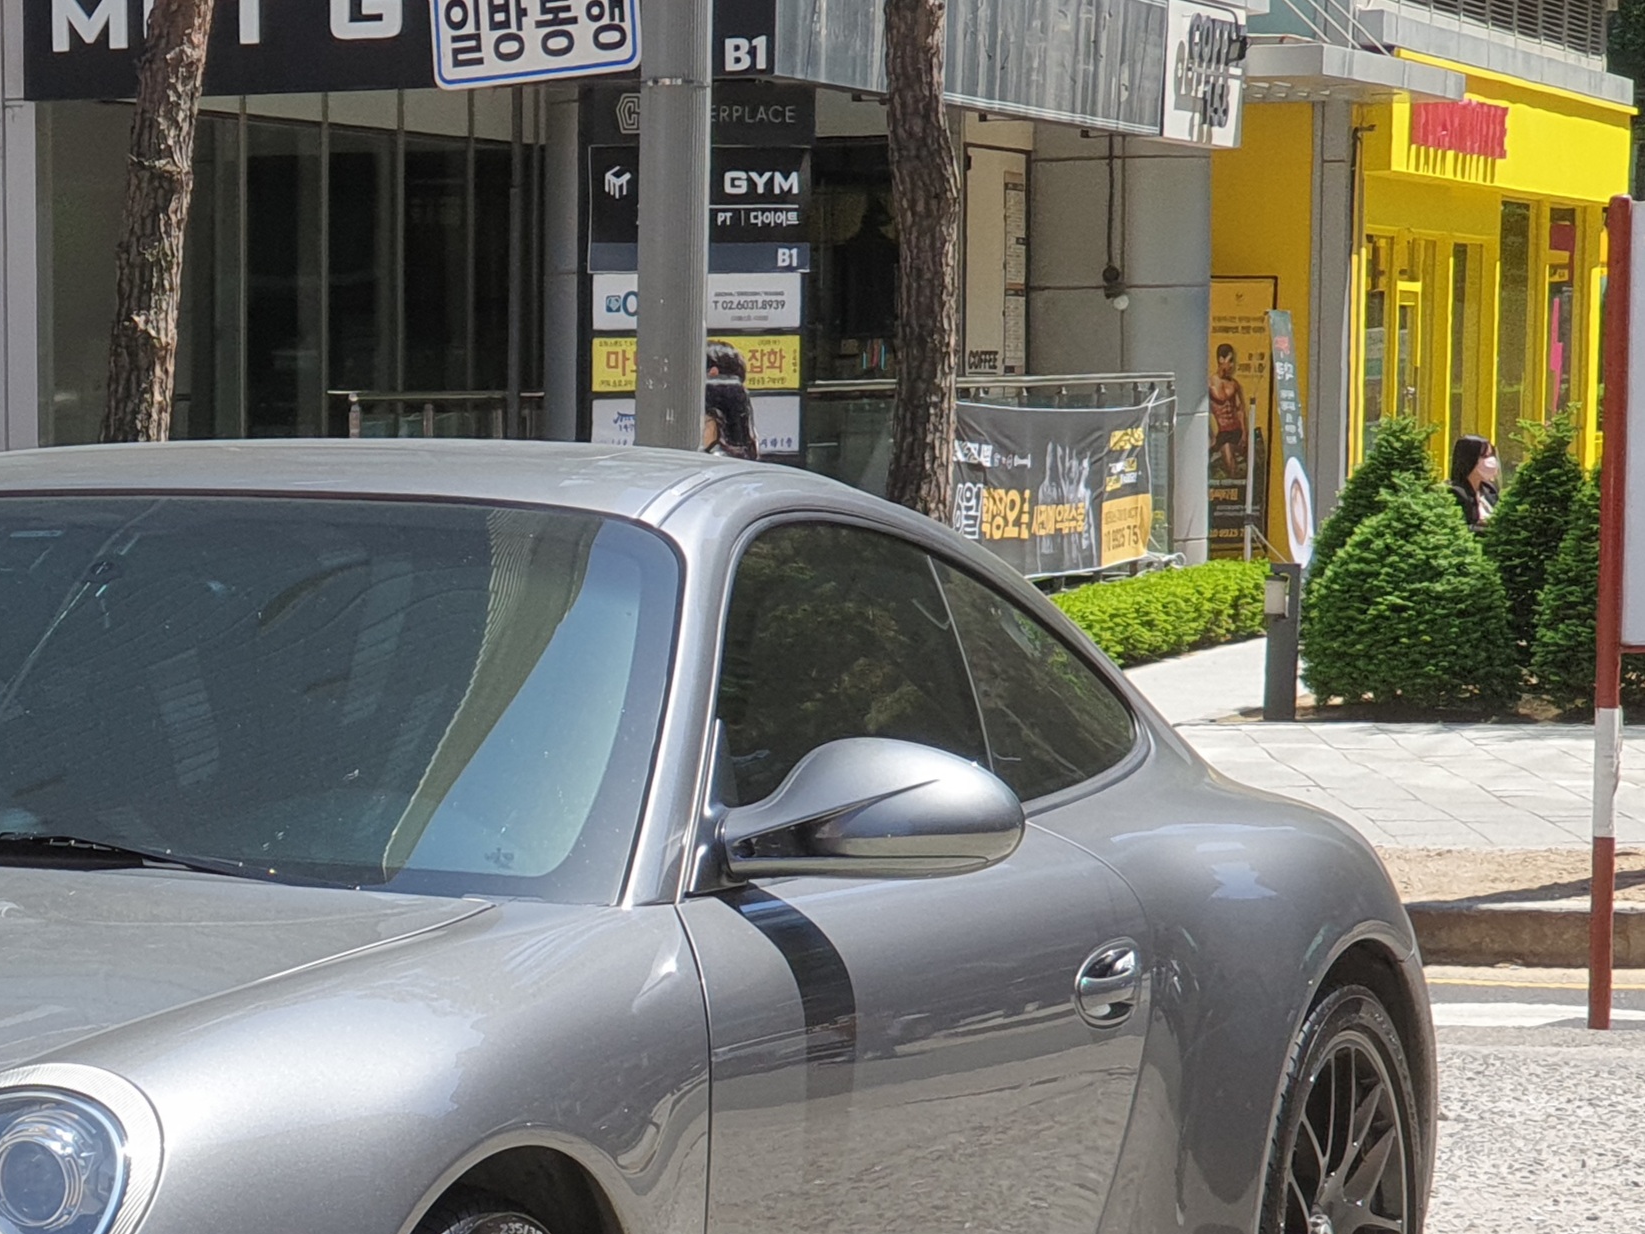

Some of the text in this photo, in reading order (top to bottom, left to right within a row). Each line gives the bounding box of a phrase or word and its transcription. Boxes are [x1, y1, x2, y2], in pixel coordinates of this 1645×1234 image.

[724, 35, 767, 71] B1
[723, 171, 799, 195] GYM
[717, 212, 732, 226] PT
[750, 210, 800, 227] 다이어트
[777, 247, 798, 268] B1
[721, 300, 786, 311] 02.6031.8939
[968, 350, 999, 370] COFFEE
